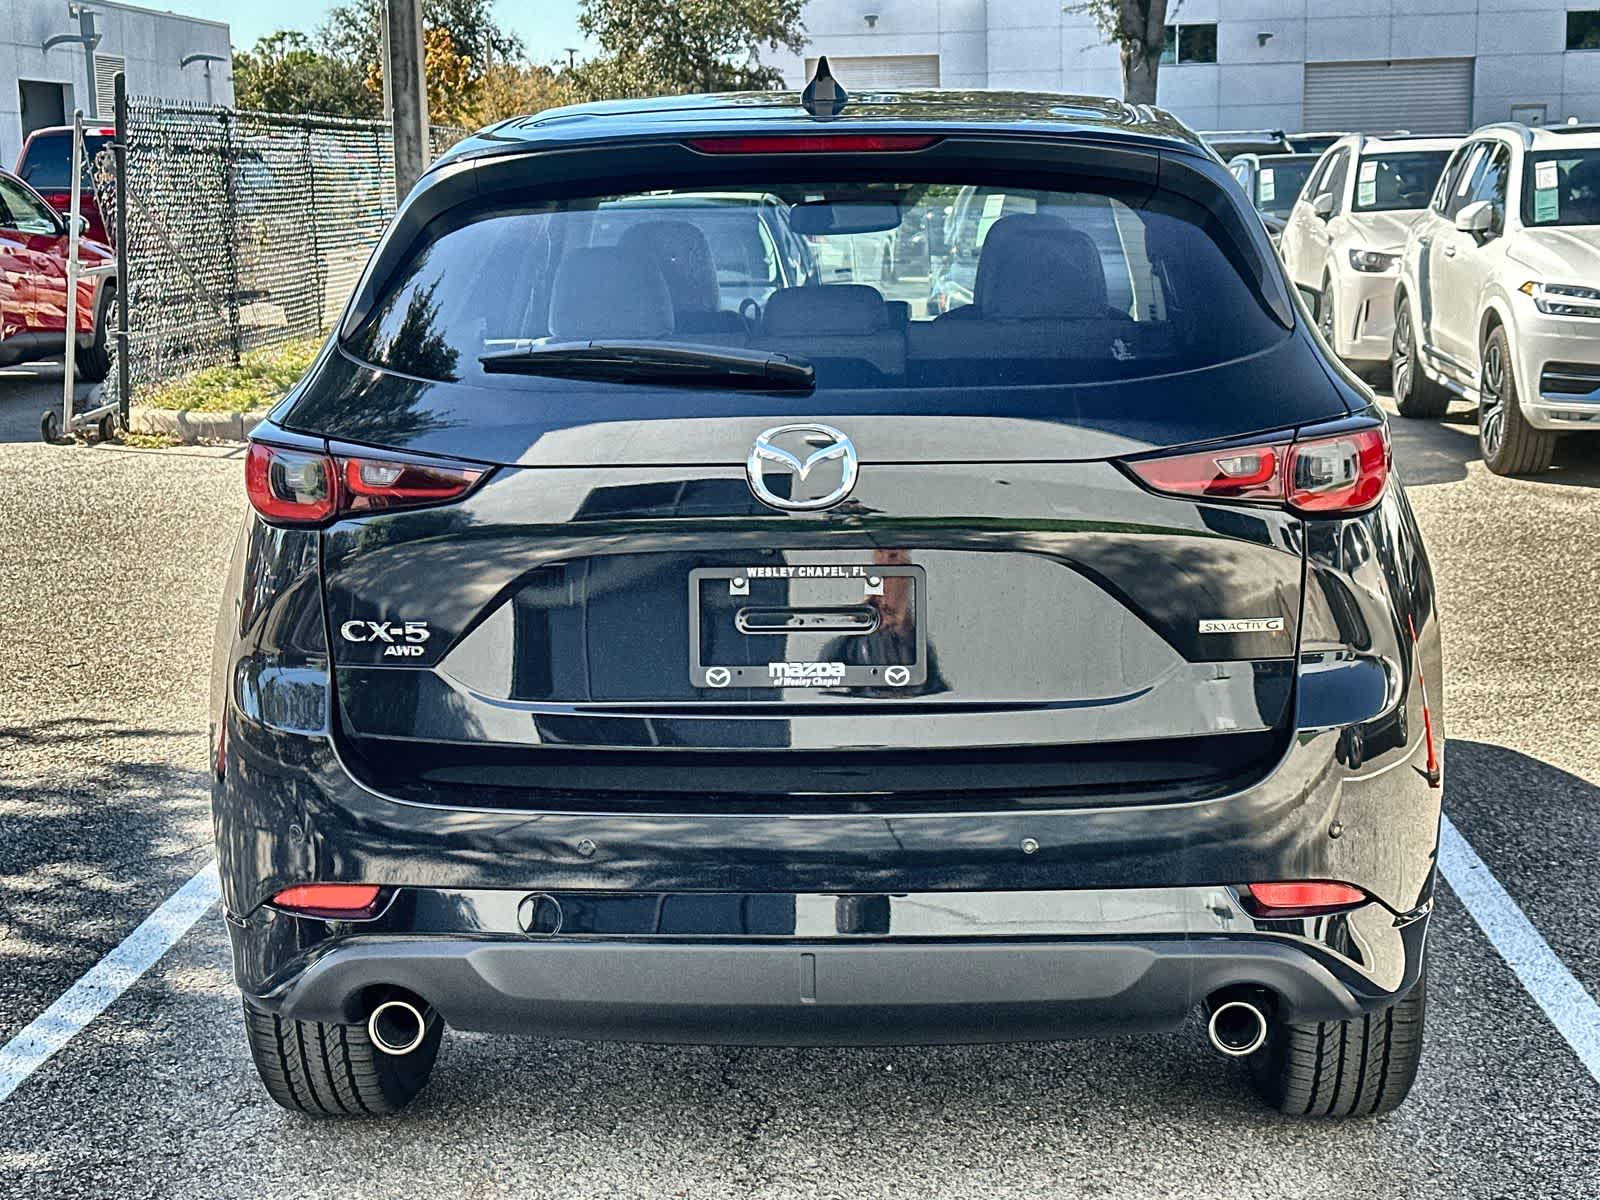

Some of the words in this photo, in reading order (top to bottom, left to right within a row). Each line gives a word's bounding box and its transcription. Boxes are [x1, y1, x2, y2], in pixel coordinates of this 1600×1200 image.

[747, 567, 795, 577] WESLEY
[798, 567, 849, 578] CHAPEL,
[852, 567, 867, 576] FL
[341, 620, 431, 643] CX-5
[384, 645, 424, 656] AWD
[783, 677, 811, 688] Wesley
[812, 676, 841, 688] Chapel
